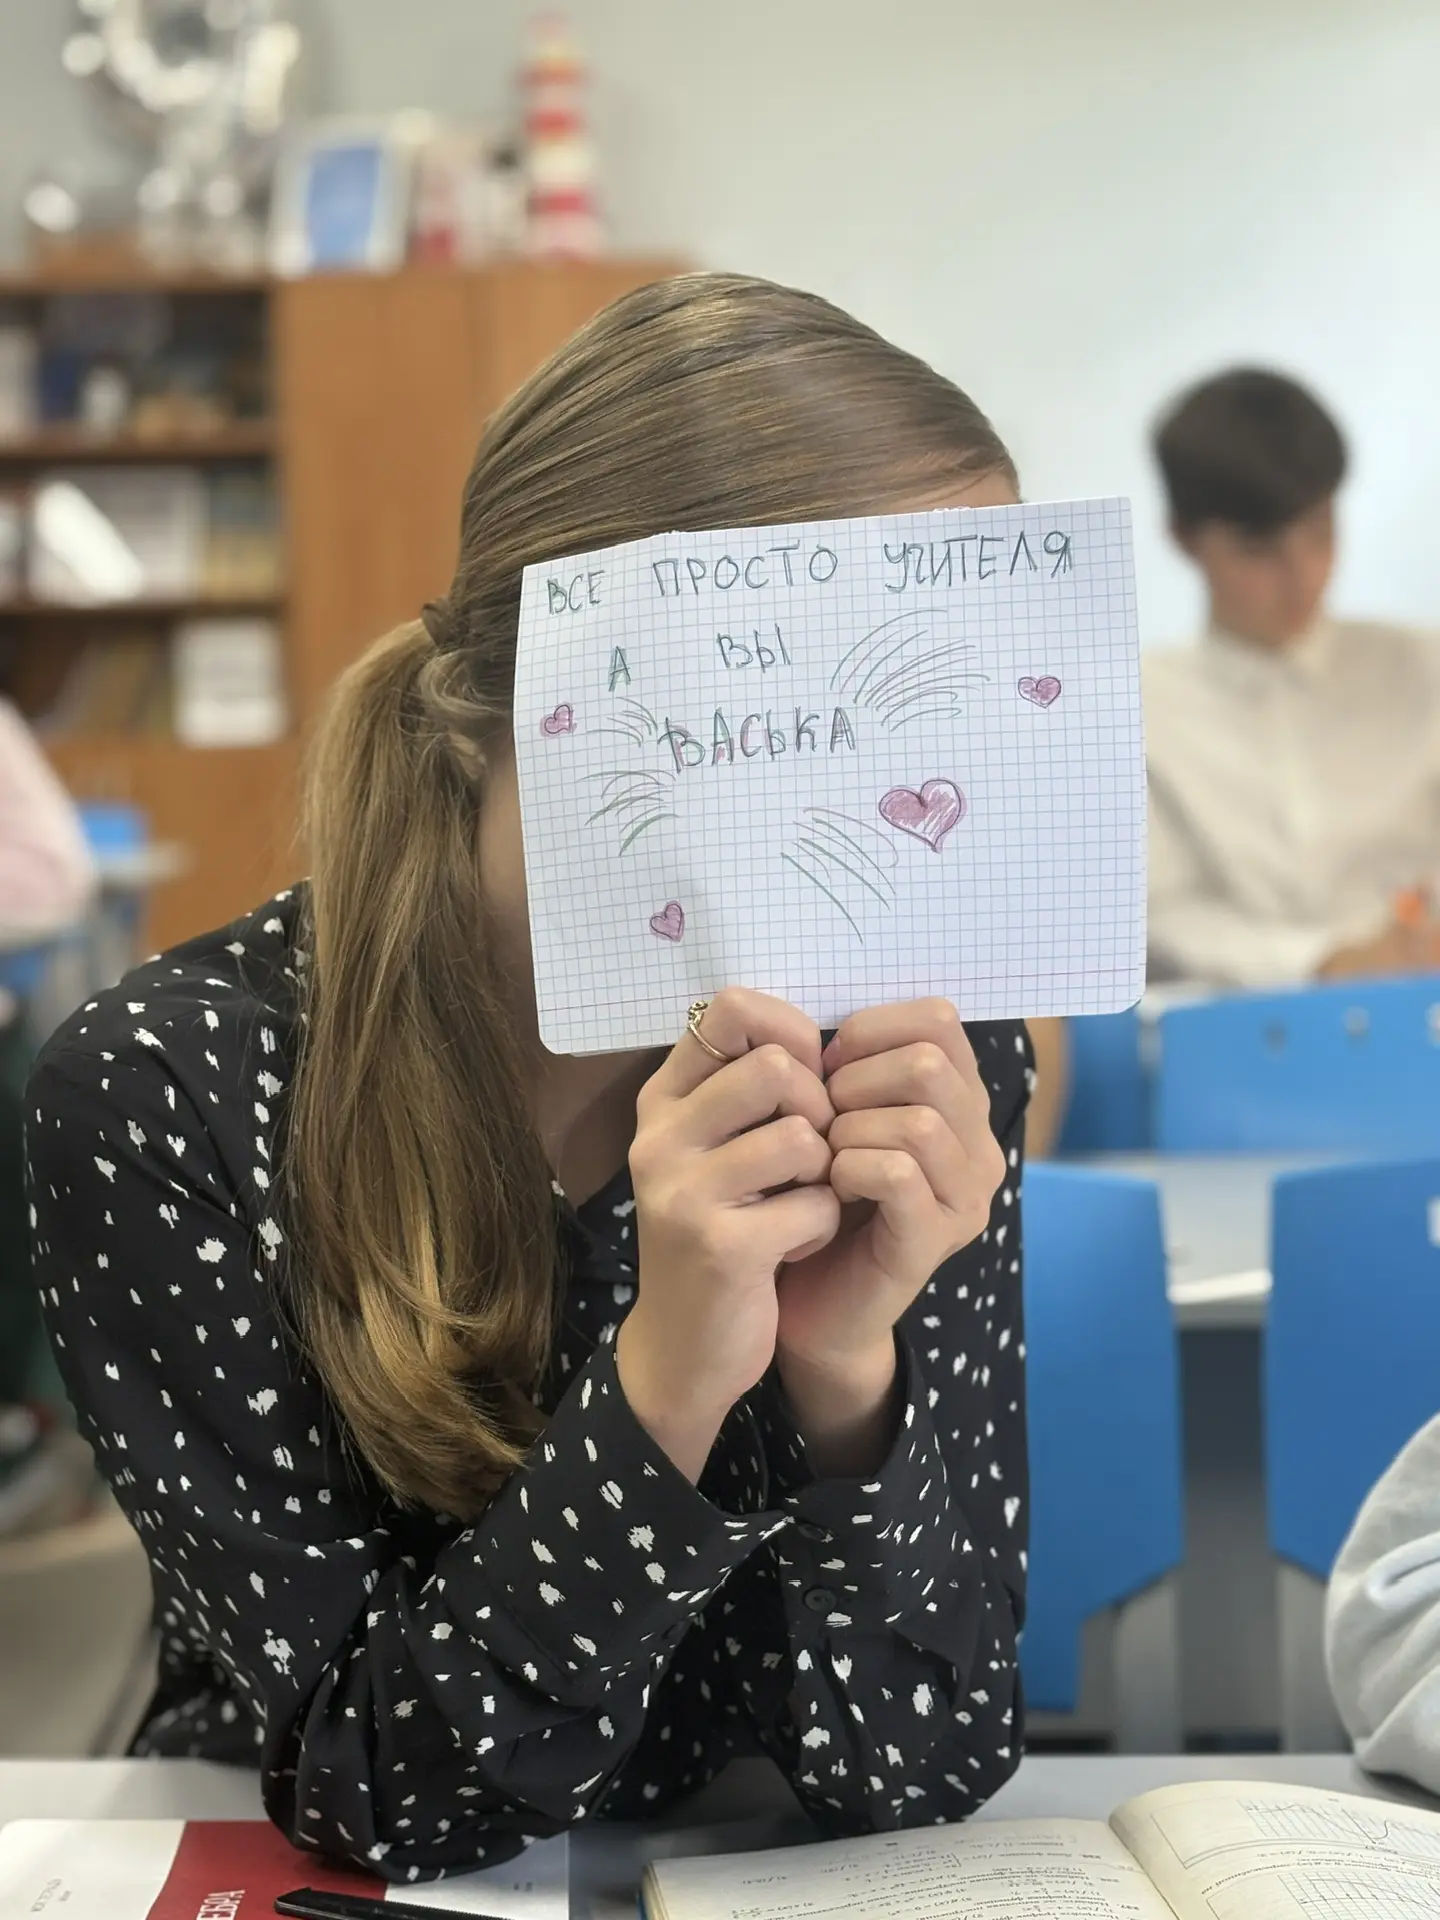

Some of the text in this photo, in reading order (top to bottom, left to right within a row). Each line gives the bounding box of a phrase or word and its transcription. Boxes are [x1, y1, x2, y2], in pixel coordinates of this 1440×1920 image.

[547, 530, 1074, 615] ВСЕ ПРОСТО УЧИТЕЛЯ
[608, 622, 791, 692] А ВЫ
[657, 706, 856, 774] ВАСЬКА
